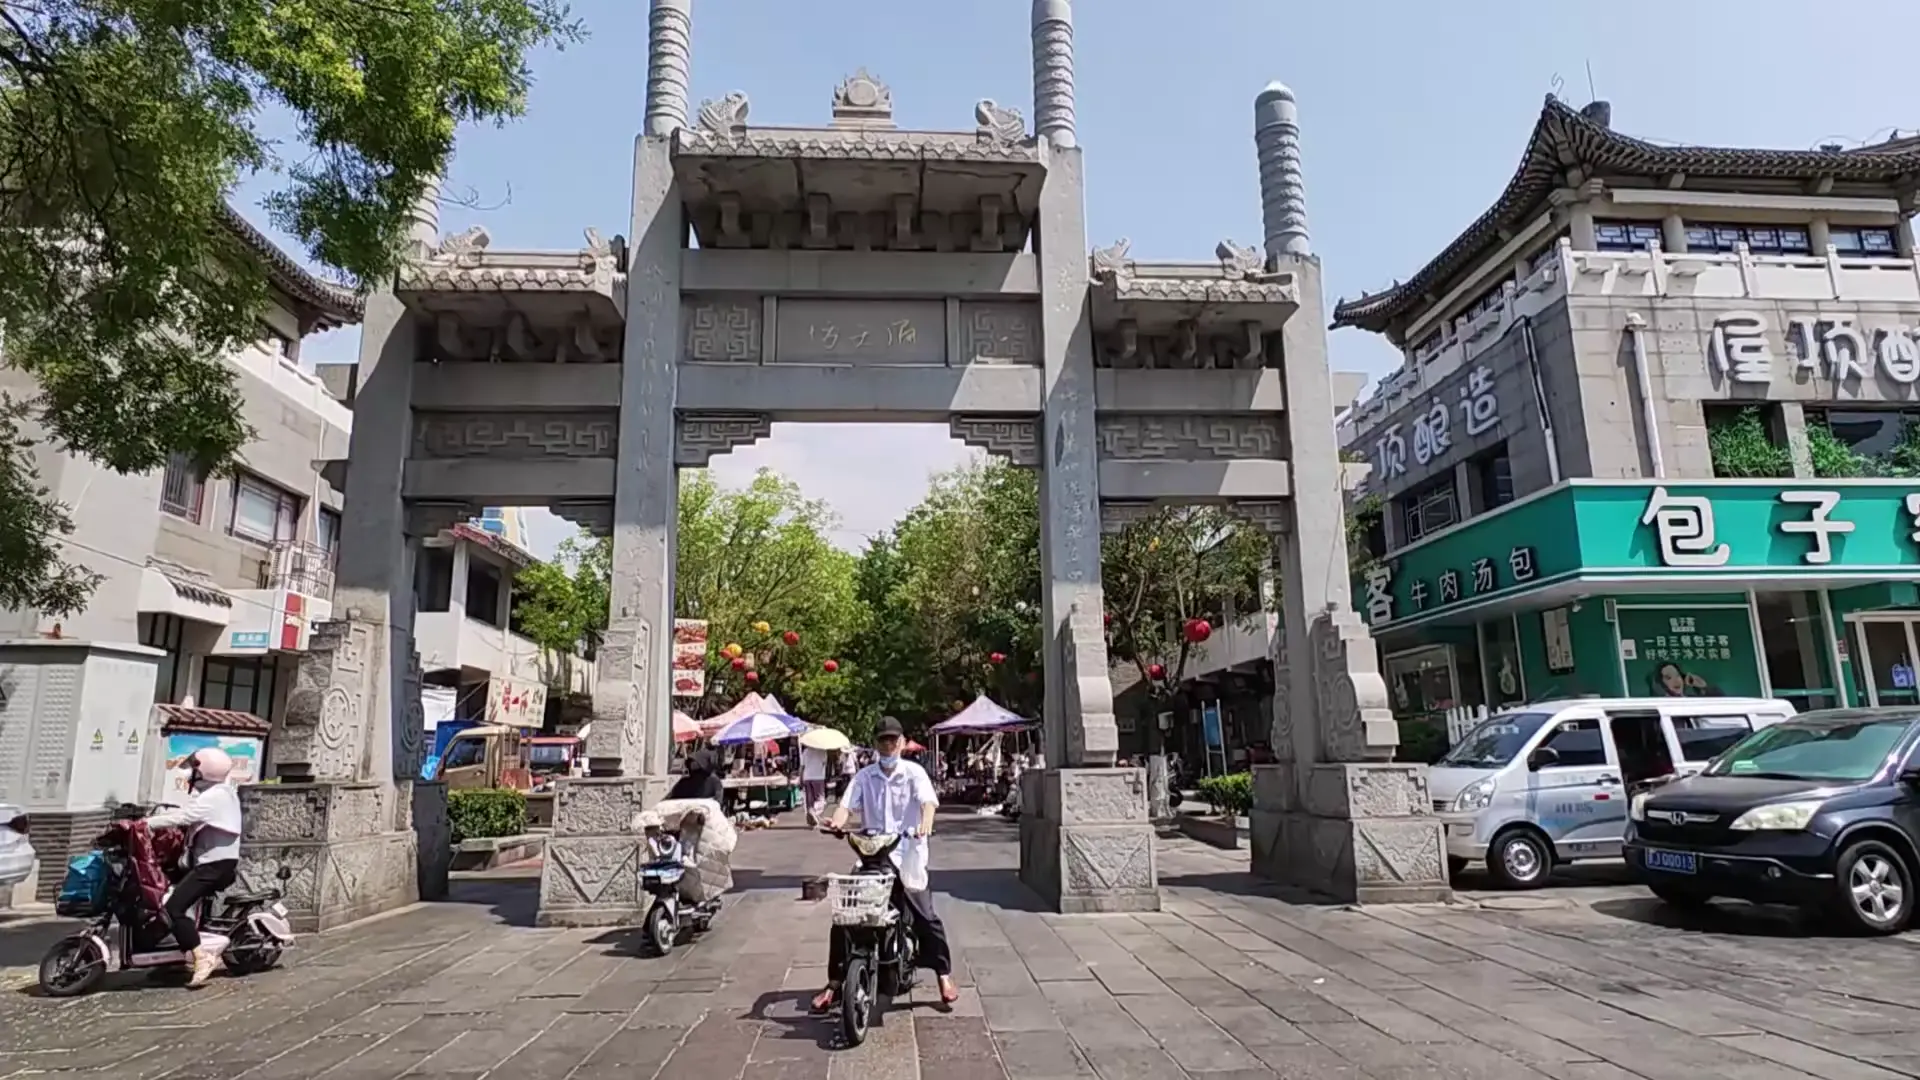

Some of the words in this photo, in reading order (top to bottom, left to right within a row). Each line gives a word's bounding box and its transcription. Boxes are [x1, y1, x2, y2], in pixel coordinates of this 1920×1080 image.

[1376, 365, 1500, 481] 顶酿造
[1642, 486, 1920, 566] 包子
[1364, 564, 1394, 625] 客
[1410, 546, 1534, 609] 牛肉汤包
[1643, 635, 1729, 647] 一日三餐包子客
